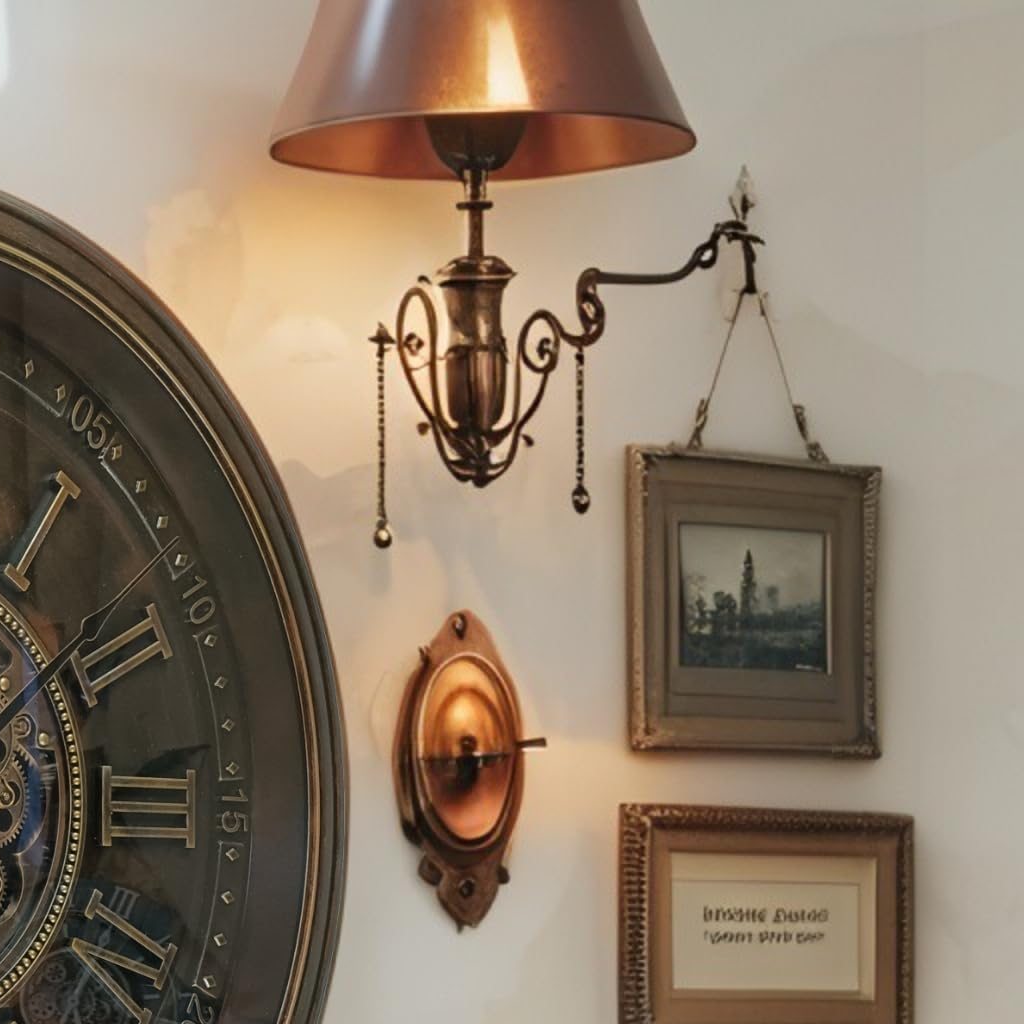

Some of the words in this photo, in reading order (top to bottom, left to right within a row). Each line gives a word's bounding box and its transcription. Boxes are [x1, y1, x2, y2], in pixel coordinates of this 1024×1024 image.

[71, 395, 113, 449] 05
[4, 471, 81, 592] I
[182, 576, 216, 625] 10
[72, 603, 173, 708] II
[101, 765, 196, 848] III
[221, 788, 249, 833] 15
